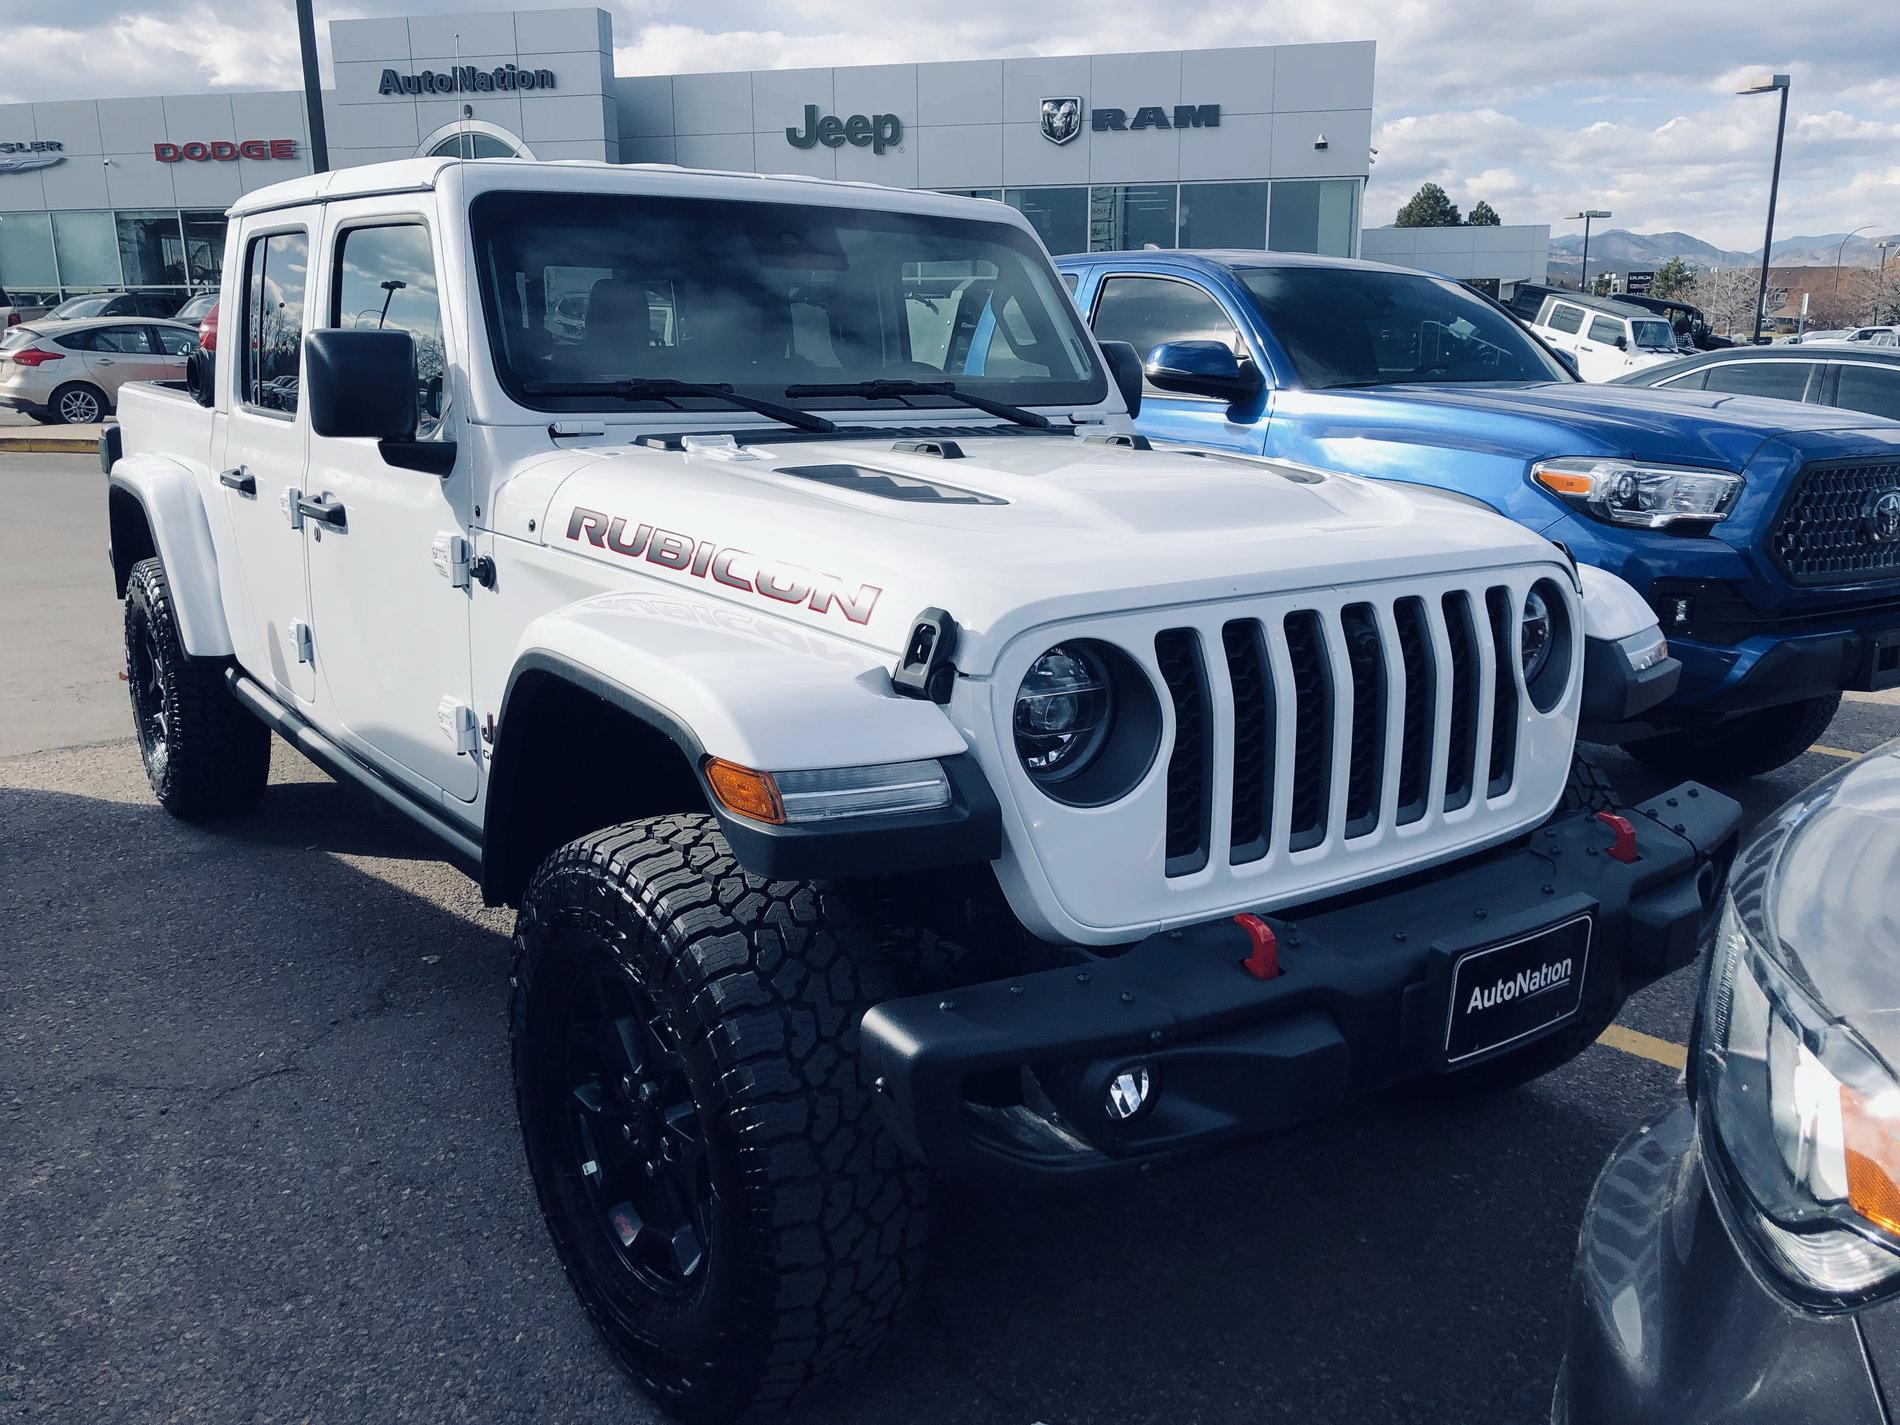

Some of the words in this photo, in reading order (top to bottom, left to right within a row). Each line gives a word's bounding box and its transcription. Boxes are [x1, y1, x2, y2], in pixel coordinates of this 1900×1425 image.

[378, 64, 557, 95] AutoNation
[786, 104, 902, 155] Jeep
[1091, 104, 1220, 131] RAM
[154, 139, 297, 162] DODGE
[566, 506, 883, 626] RUBICON
[1466, 958, 1572, 1014] AutoNation
